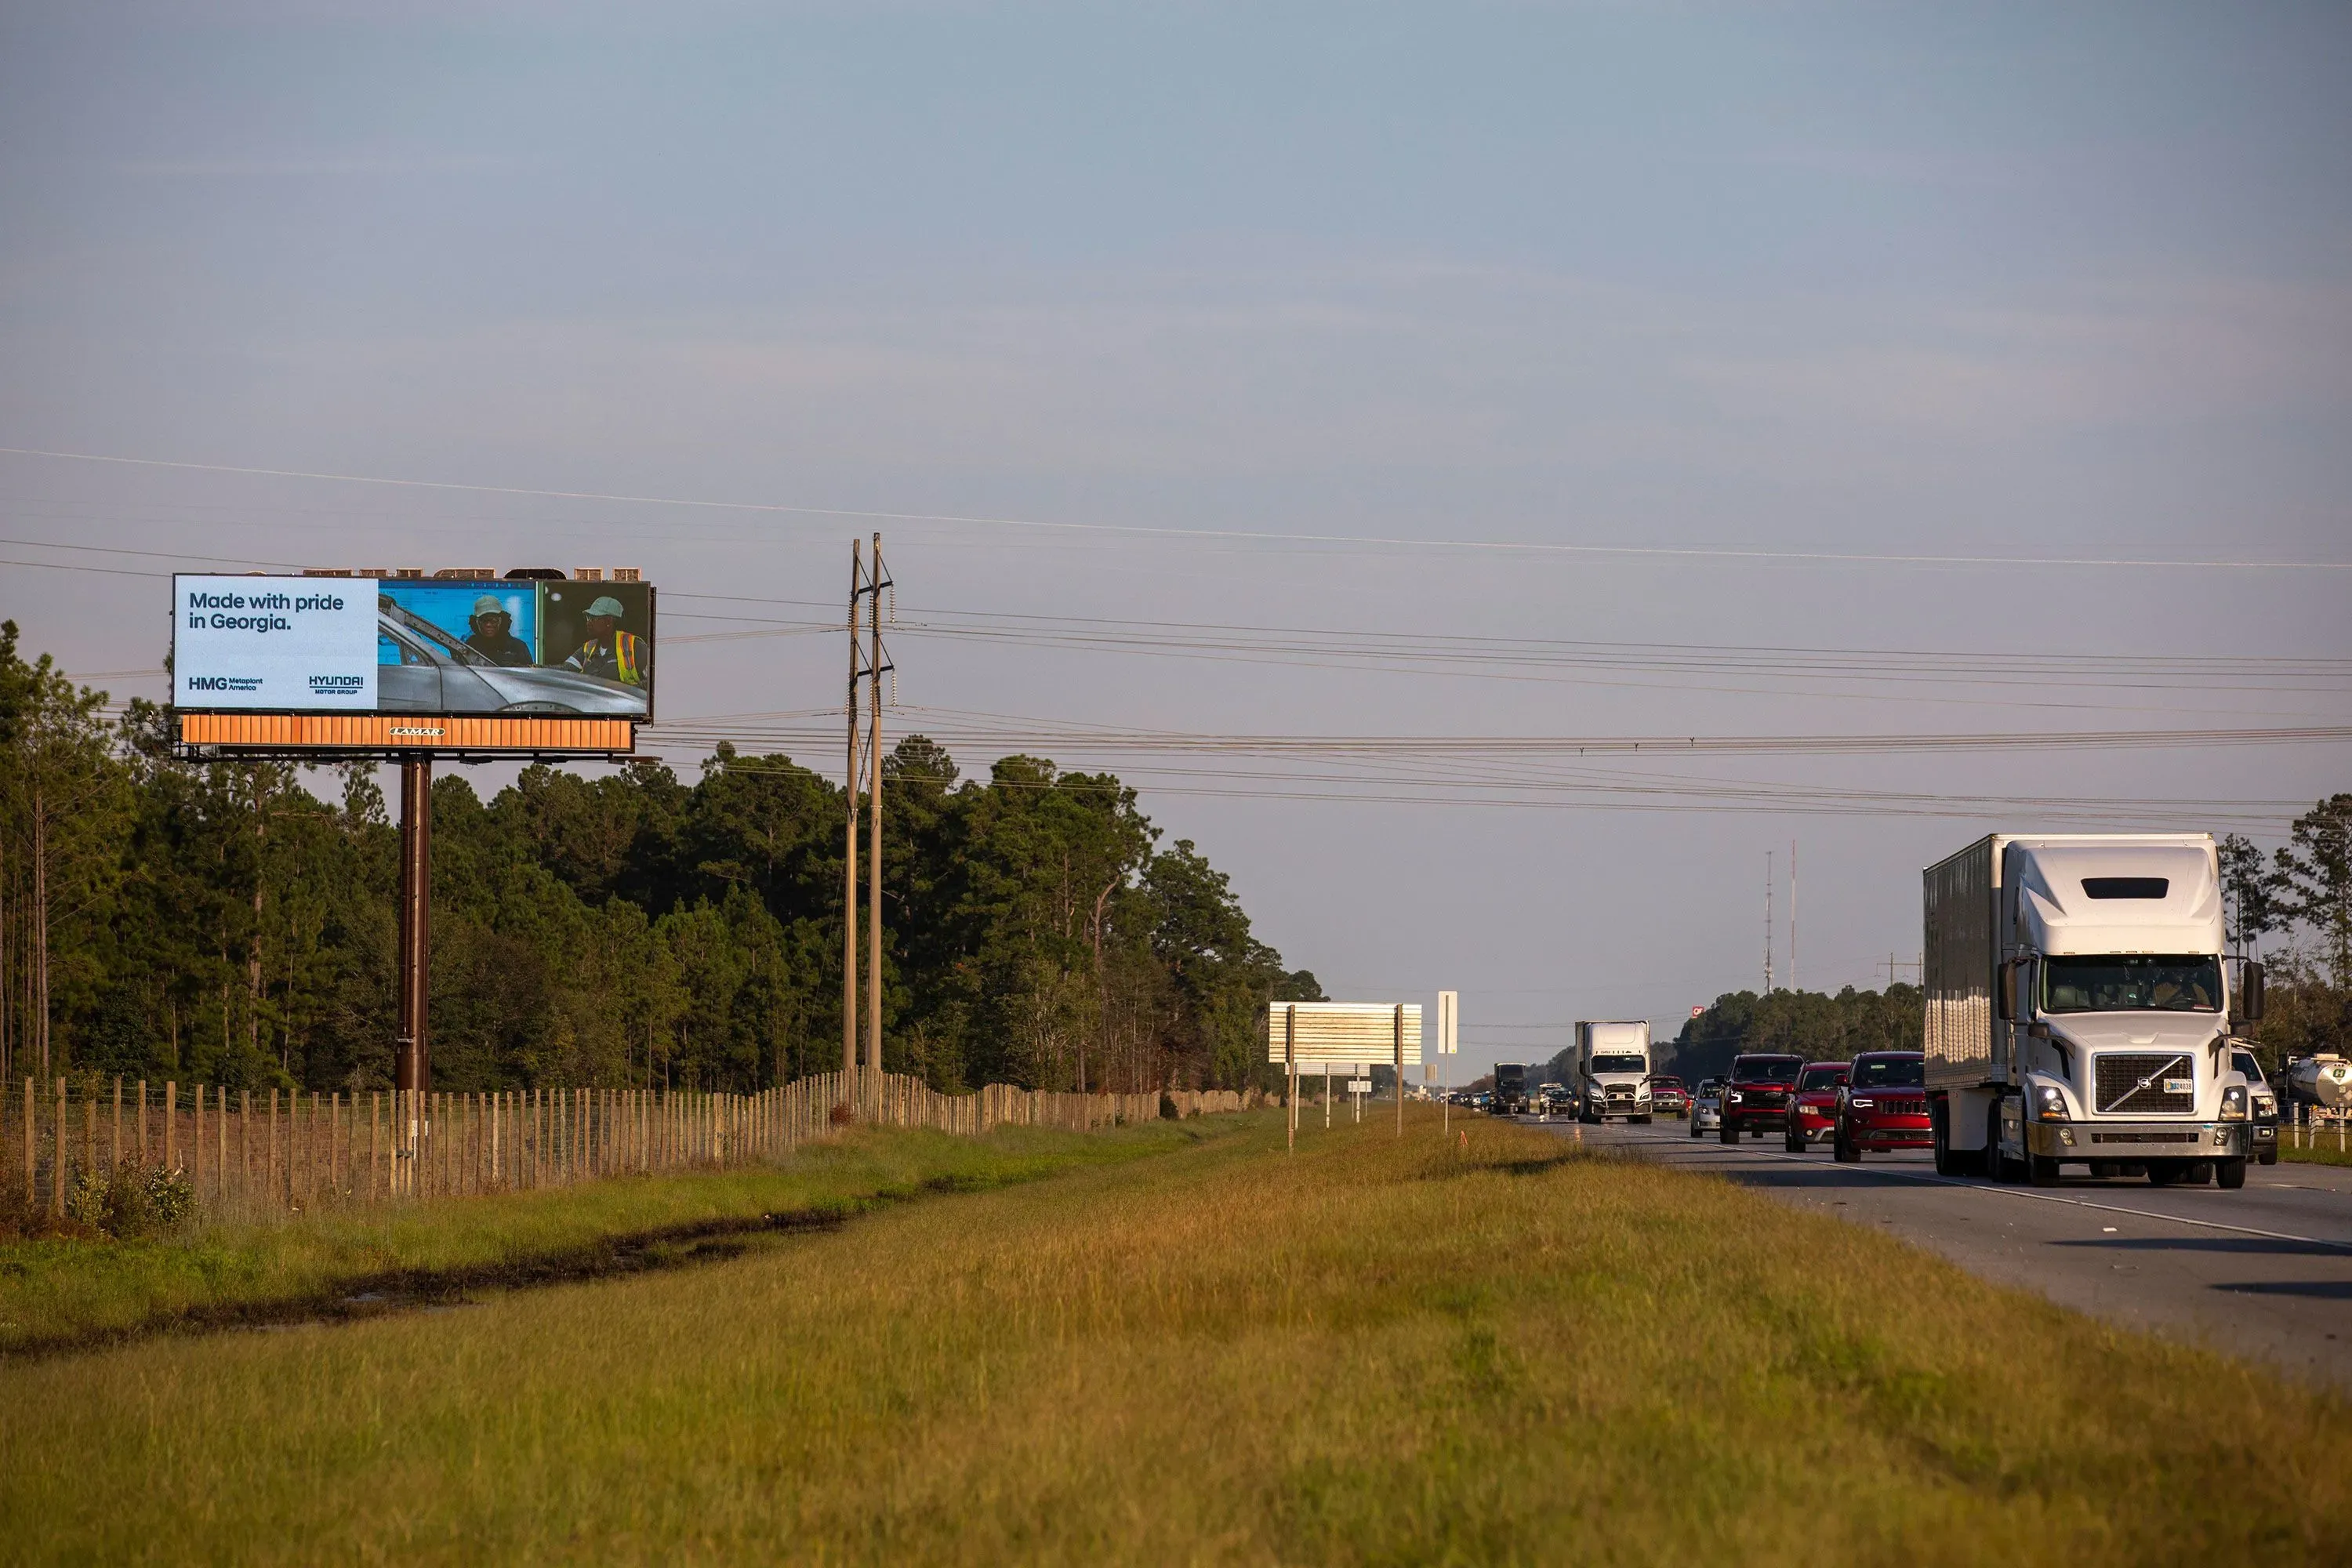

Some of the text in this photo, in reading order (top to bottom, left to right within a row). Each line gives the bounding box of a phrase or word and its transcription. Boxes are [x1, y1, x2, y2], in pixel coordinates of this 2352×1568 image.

[190, 593, 344, 613] Made with pride
[189, 612, 292, 633] in Georgia.
[189, 677, 227, 690] HMG
[309, 676, 364, 685] HYUNDAI
